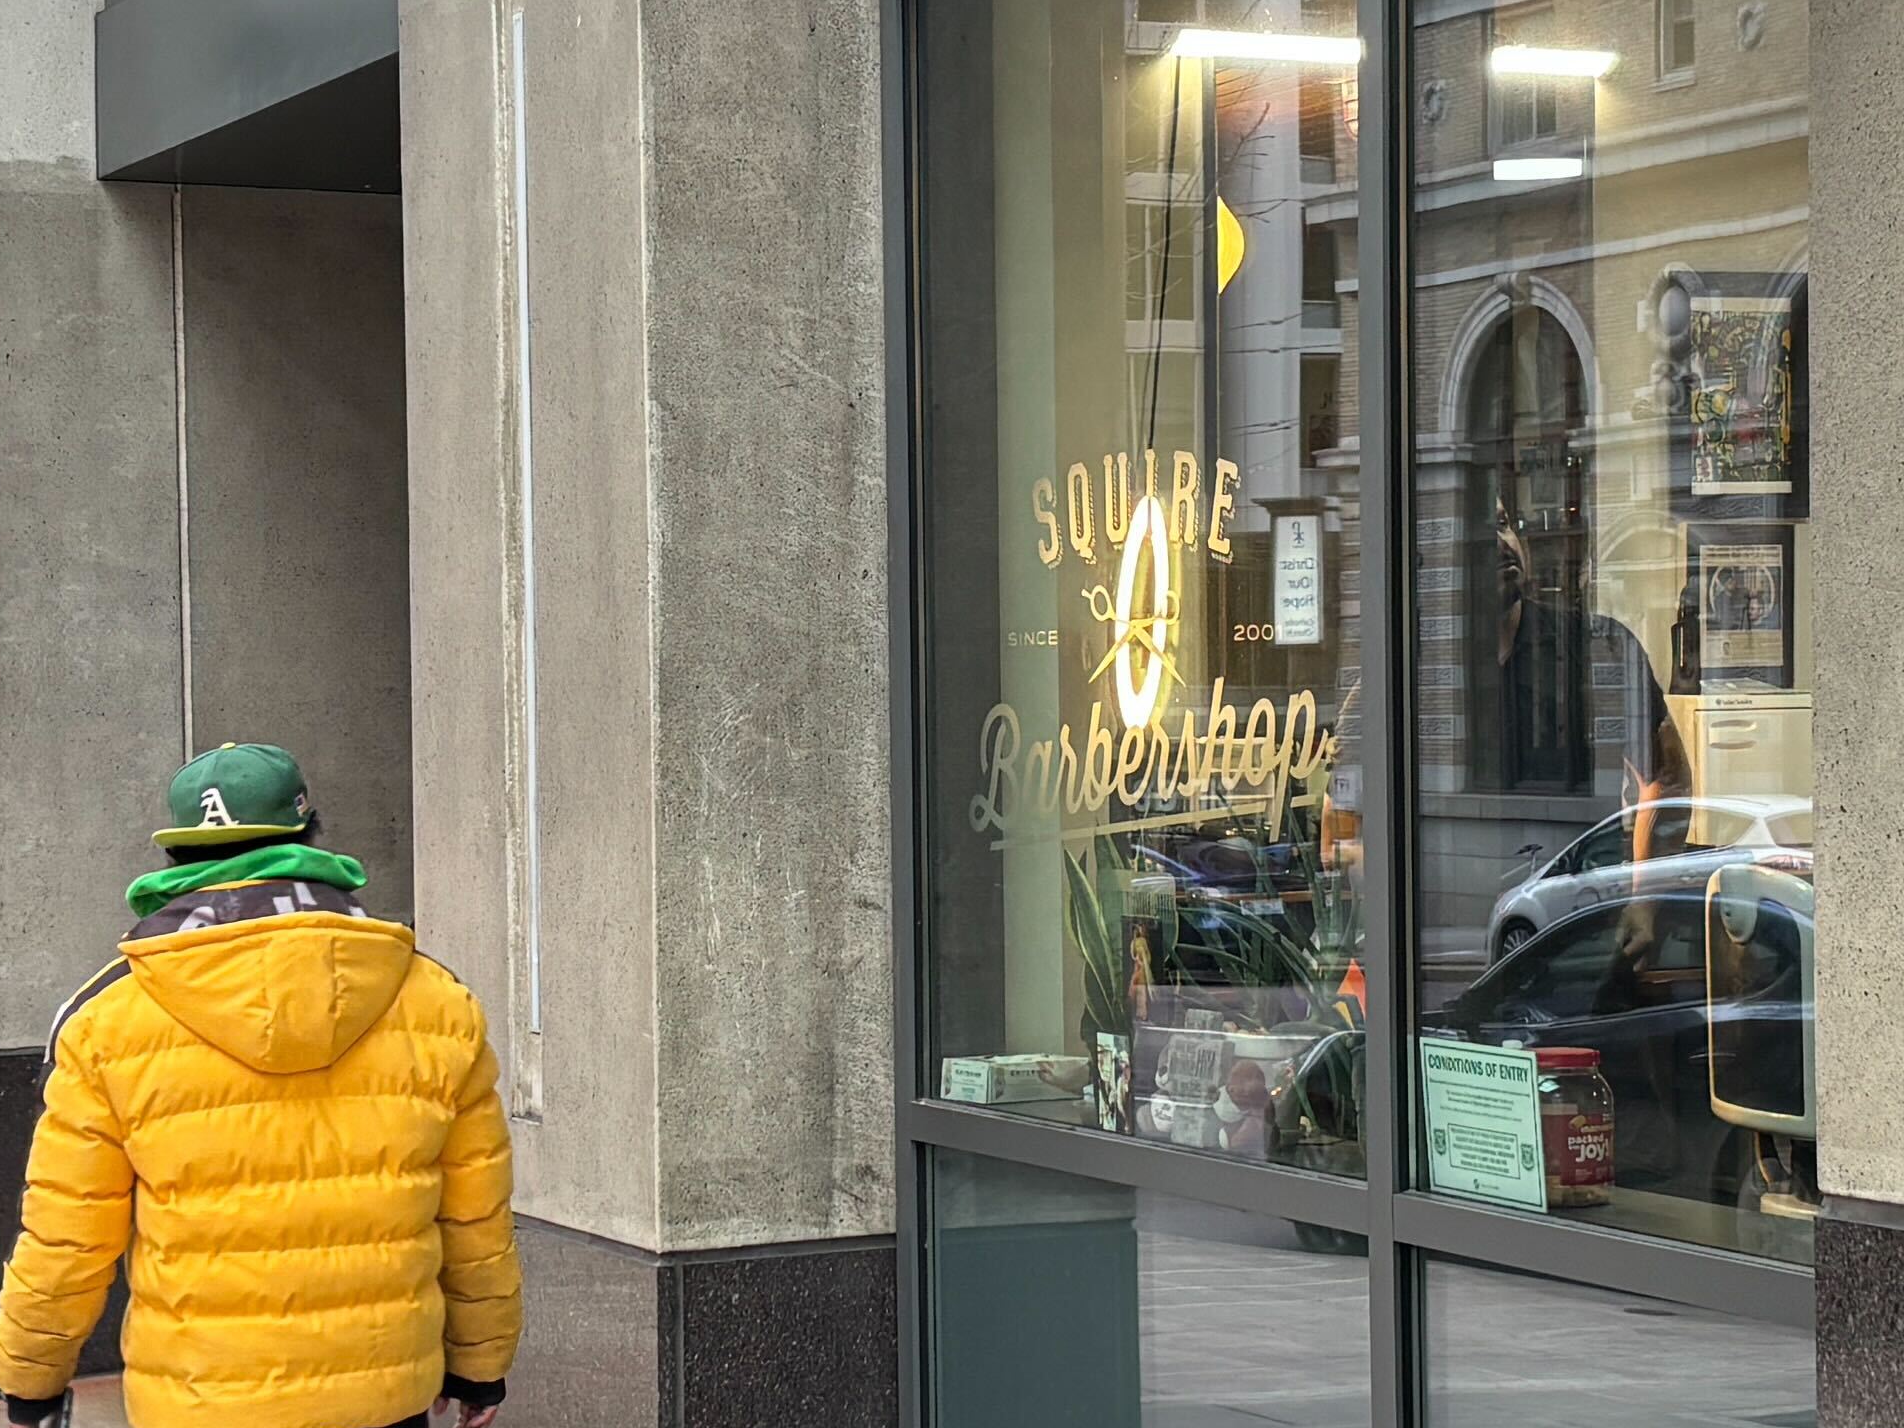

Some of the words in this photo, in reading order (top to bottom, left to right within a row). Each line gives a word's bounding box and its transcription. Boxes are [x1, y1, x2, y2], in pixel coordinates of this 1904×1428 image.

[1032, 449, 1241, 569] SQUIRE
[1007, 629, 1059, 647] SINCE
[1233, 623, 1284, 642] 2001
[968, 676, 1334, 844] Barbershop
[197, 787, 240, 827] A
[1428, 1053, 1484, 1076] CONDITIONS
[1485, 1062, 1497, 1078] OF
[1499, 1063, 1529, 1083] ENTRY
